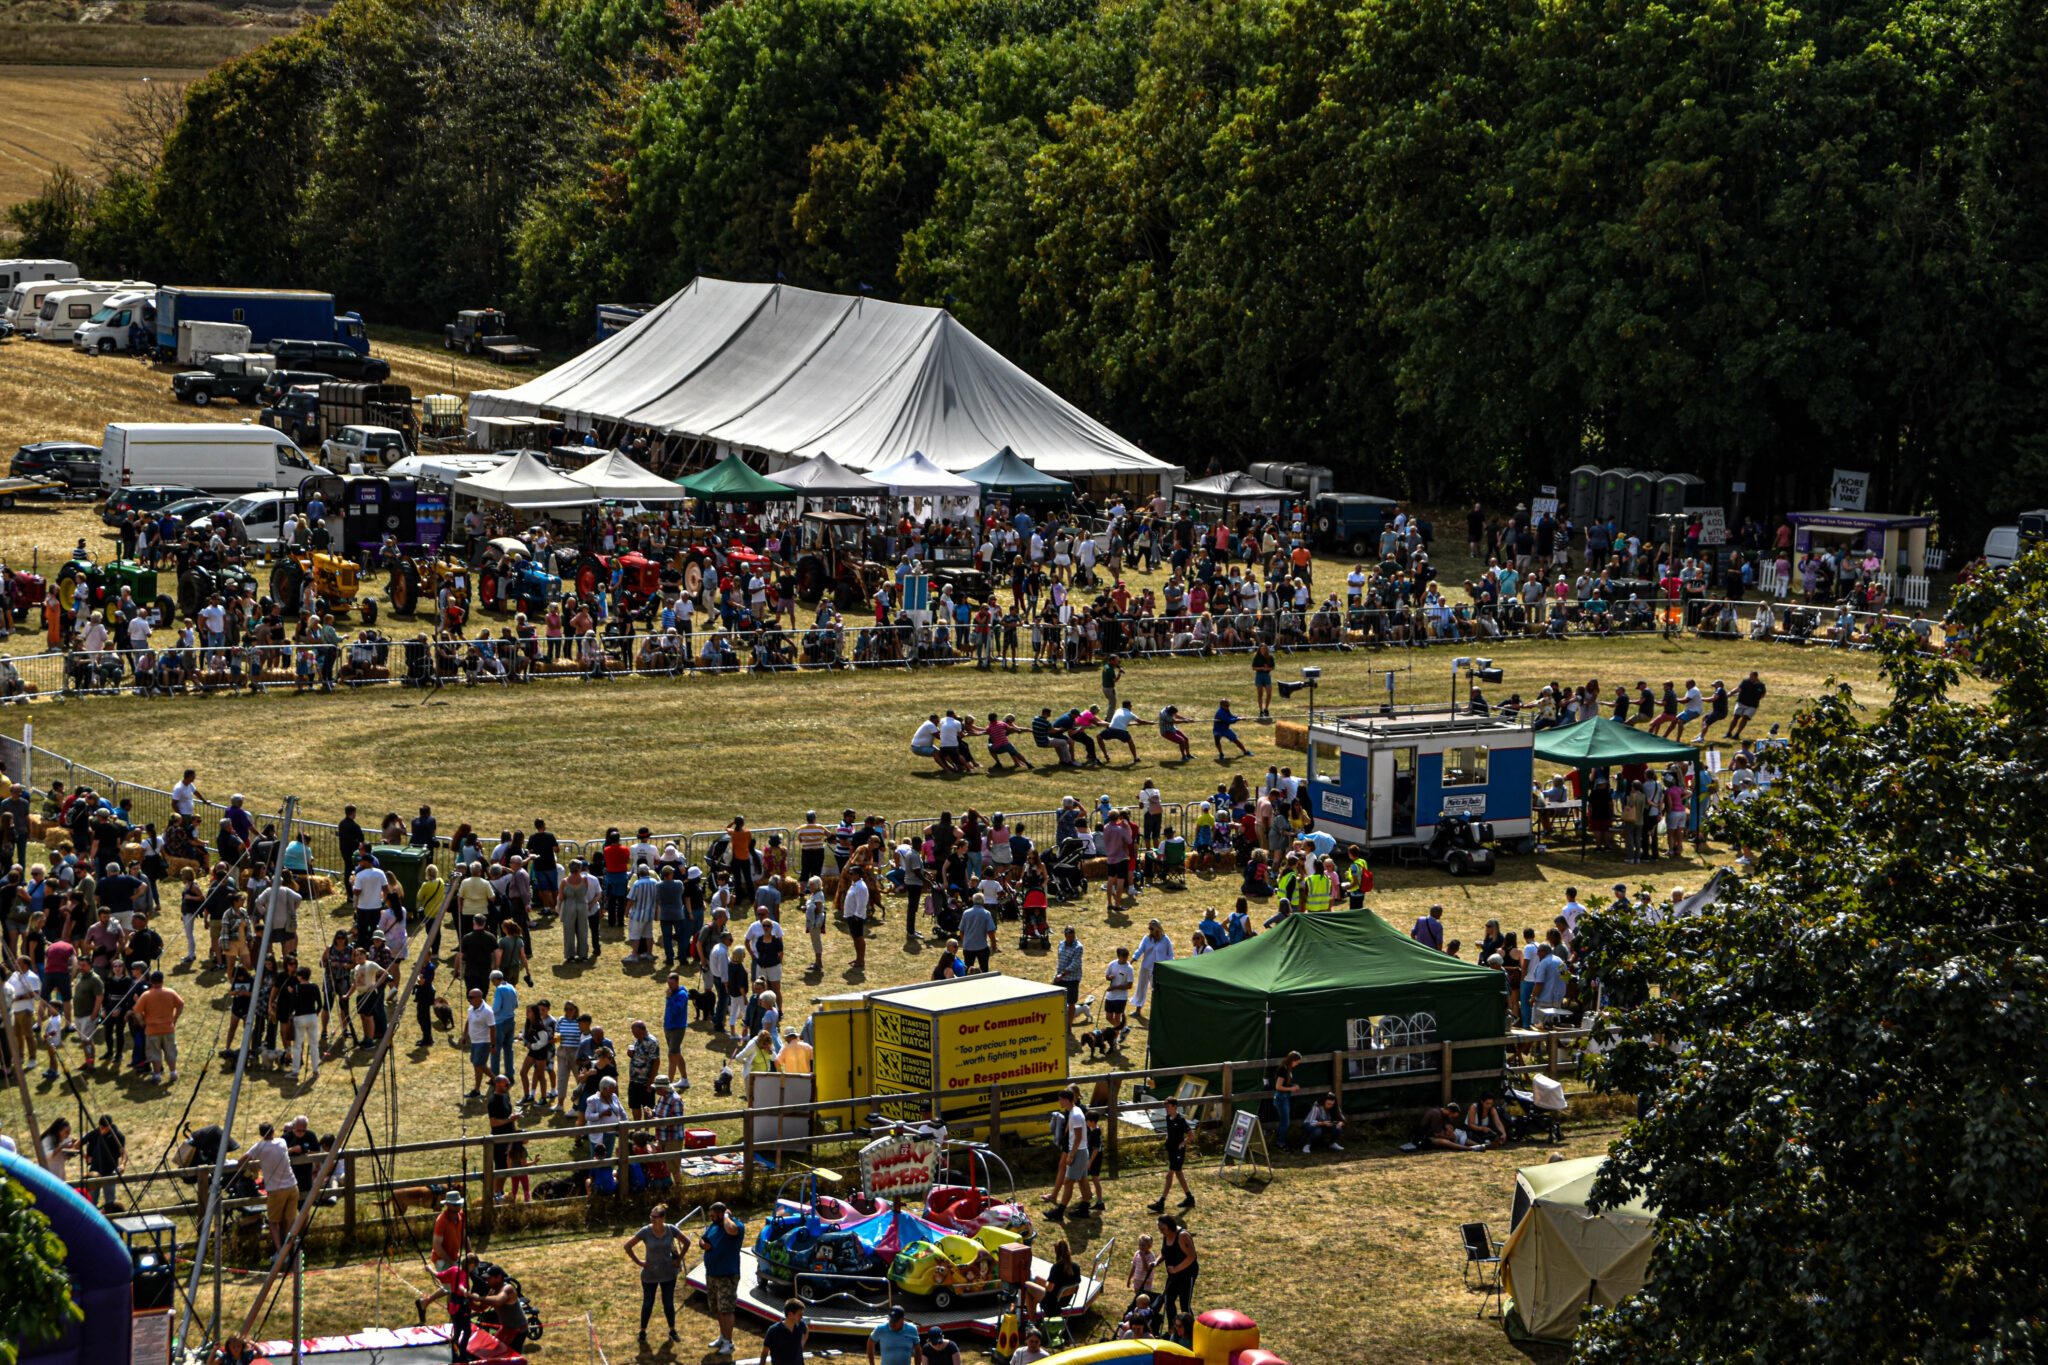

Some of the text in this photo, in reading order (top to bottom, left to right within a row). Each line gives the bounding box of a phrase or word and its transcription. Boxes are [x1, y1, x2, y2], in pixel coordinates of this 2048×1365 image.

[1838, 477, 1864, 487] MORE
[1841, 486, 1860, 495] THIS
[1839, 494, 1858, 502] WAY
[1217, 797, 1230, 810] 24
[901, 1018, 930, 1031] STANSTED
[959, 1012, 1047, 1036] Our Community
[901, 1026, 930, 1040] AIRPORT
[901, 1035, 930, 1050] WATCH
[975, 1040, 1008, 1053] precious
[1009, 1036, 1017, 1046] to
[902, 1056, 931, 1068] STANSTED
[988, 1050, 1018, 1063] fighting
[1019, 1048, 1028, 1056] to
[902, 1064, 931, 1077] AIRPORT
[948, 1059, 1060, 1089] Our Responsibility!
[902, 1072, 931, 1088] WATCH
[870, 1165, 931, 1192] RACERS
